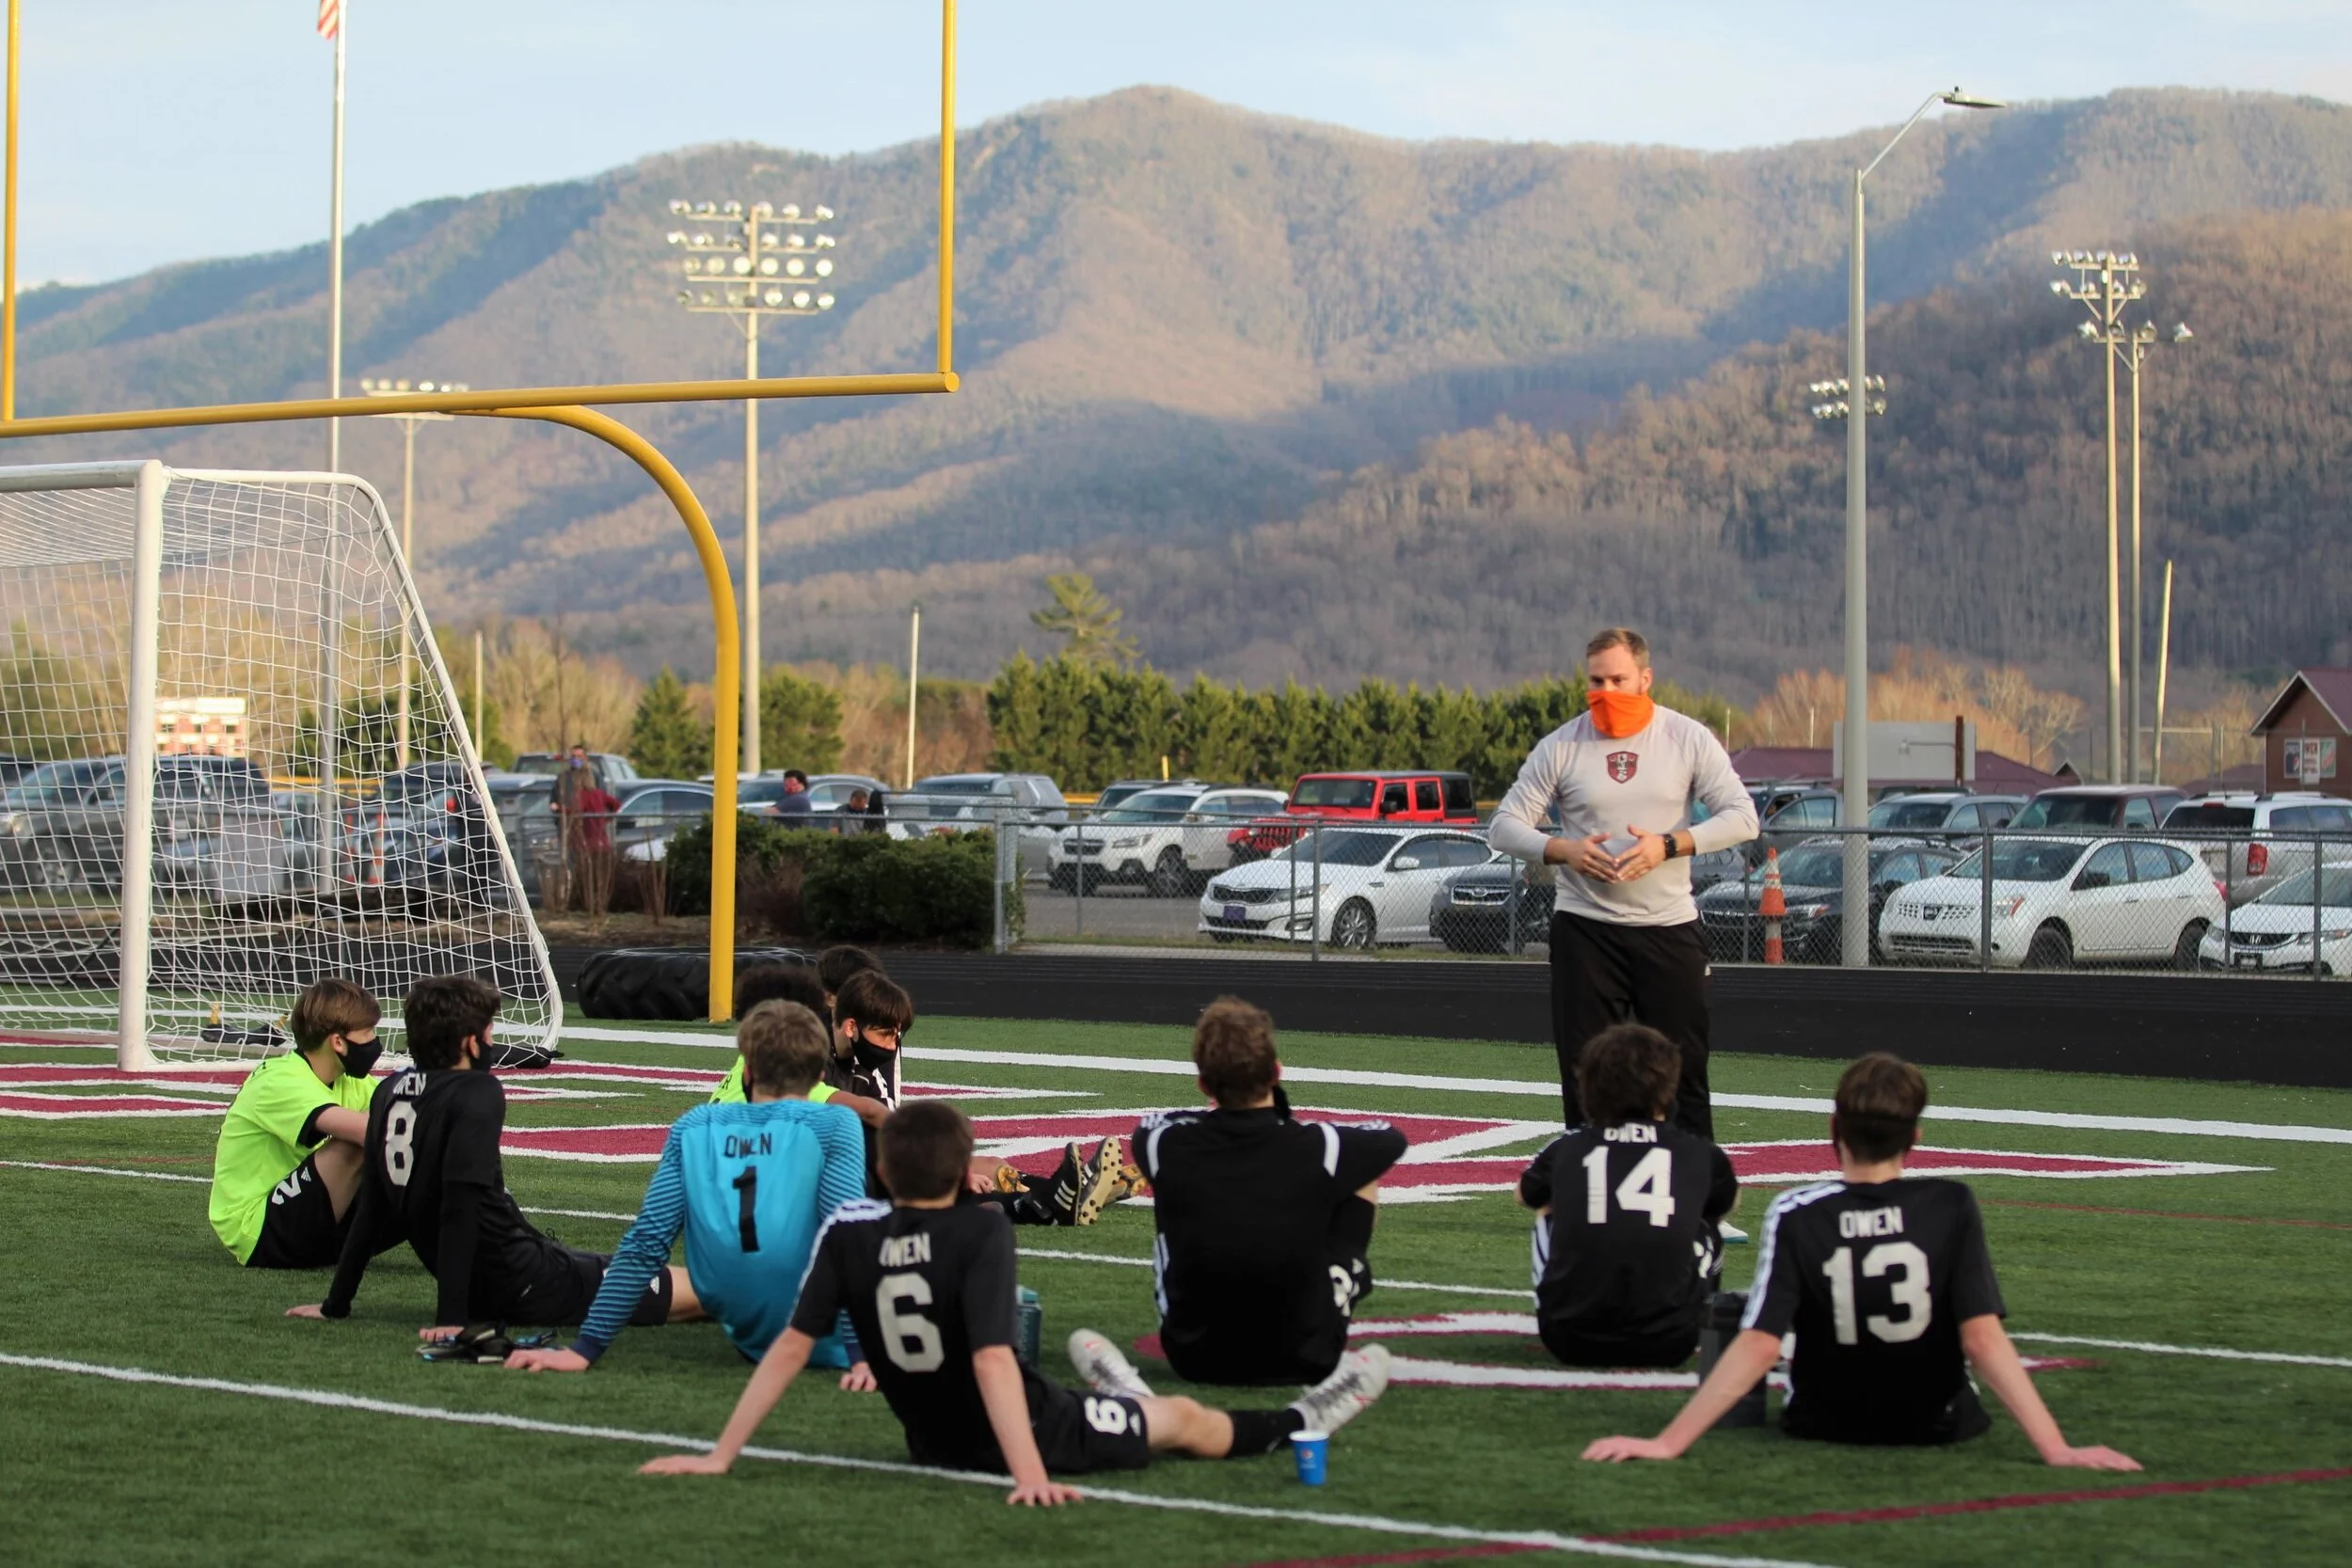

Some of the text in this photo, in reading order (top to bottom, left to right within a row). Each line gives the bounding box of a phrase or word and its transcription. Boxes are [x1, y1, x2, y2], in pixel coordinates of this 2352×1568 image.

[392, 1072, 427, 1096] WEN
[386, 1100, 417, 1186] 8
[723, 1132, 772, 1159] OWN
[1603, 1122, 1658, 1143] OWEN
[1581, 1145, 1676, 1227] 14
[732, 1165, 760, 1253] 1
[1839, 1210, 1904, 1240] OWEN
[878, 1231, 931, 1268] OWEN
[1821, 1241, 1932, 1345] 13
[875, 1272, 945, 1373] 6
[1084, 1396, 1127, 1435] 6
